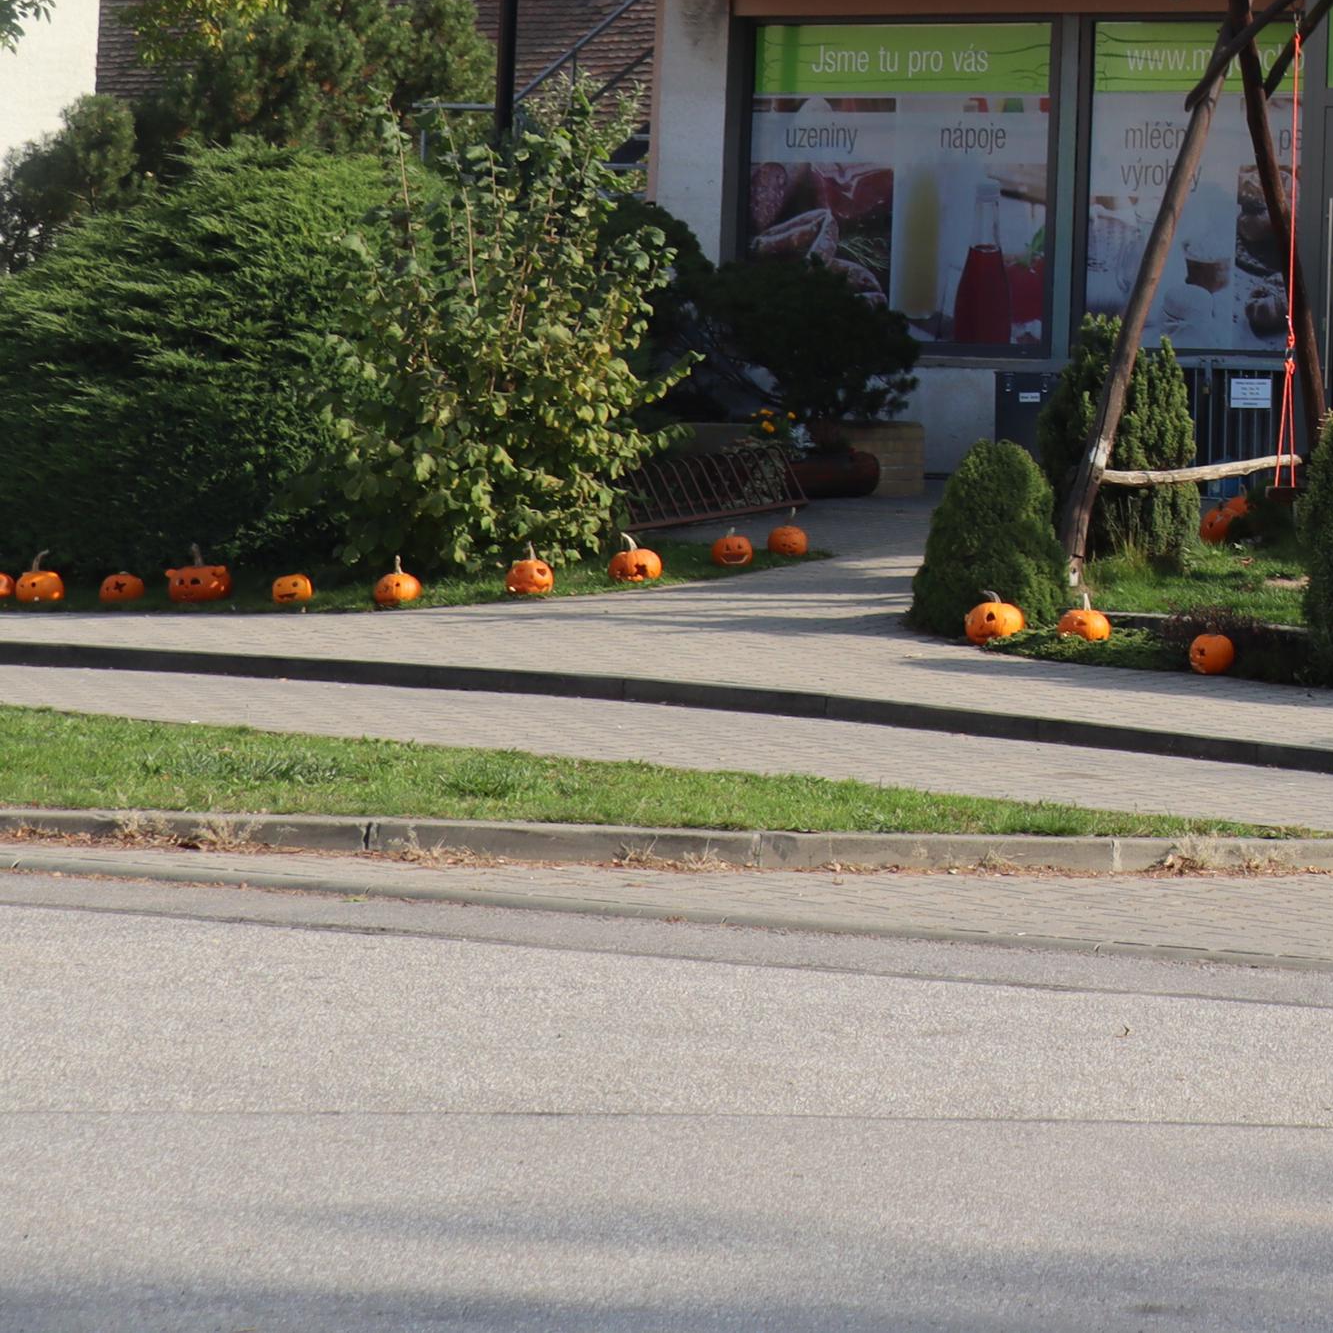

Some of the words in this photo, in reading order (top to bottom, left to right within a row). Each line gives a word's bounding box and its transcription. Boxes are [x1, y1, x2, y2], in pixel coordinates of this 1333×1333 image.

[812, 44, 869, 74] Jsme
[879, 48, 900, 73] tu
[908, 51, 944, 79] pro
[951, 43, 990, 73] vás
[785, 124, 858, 154] uzeniny
[939, 121, 1007, 154] nápoje
[1124, 120, 1188, 150] mléčn
